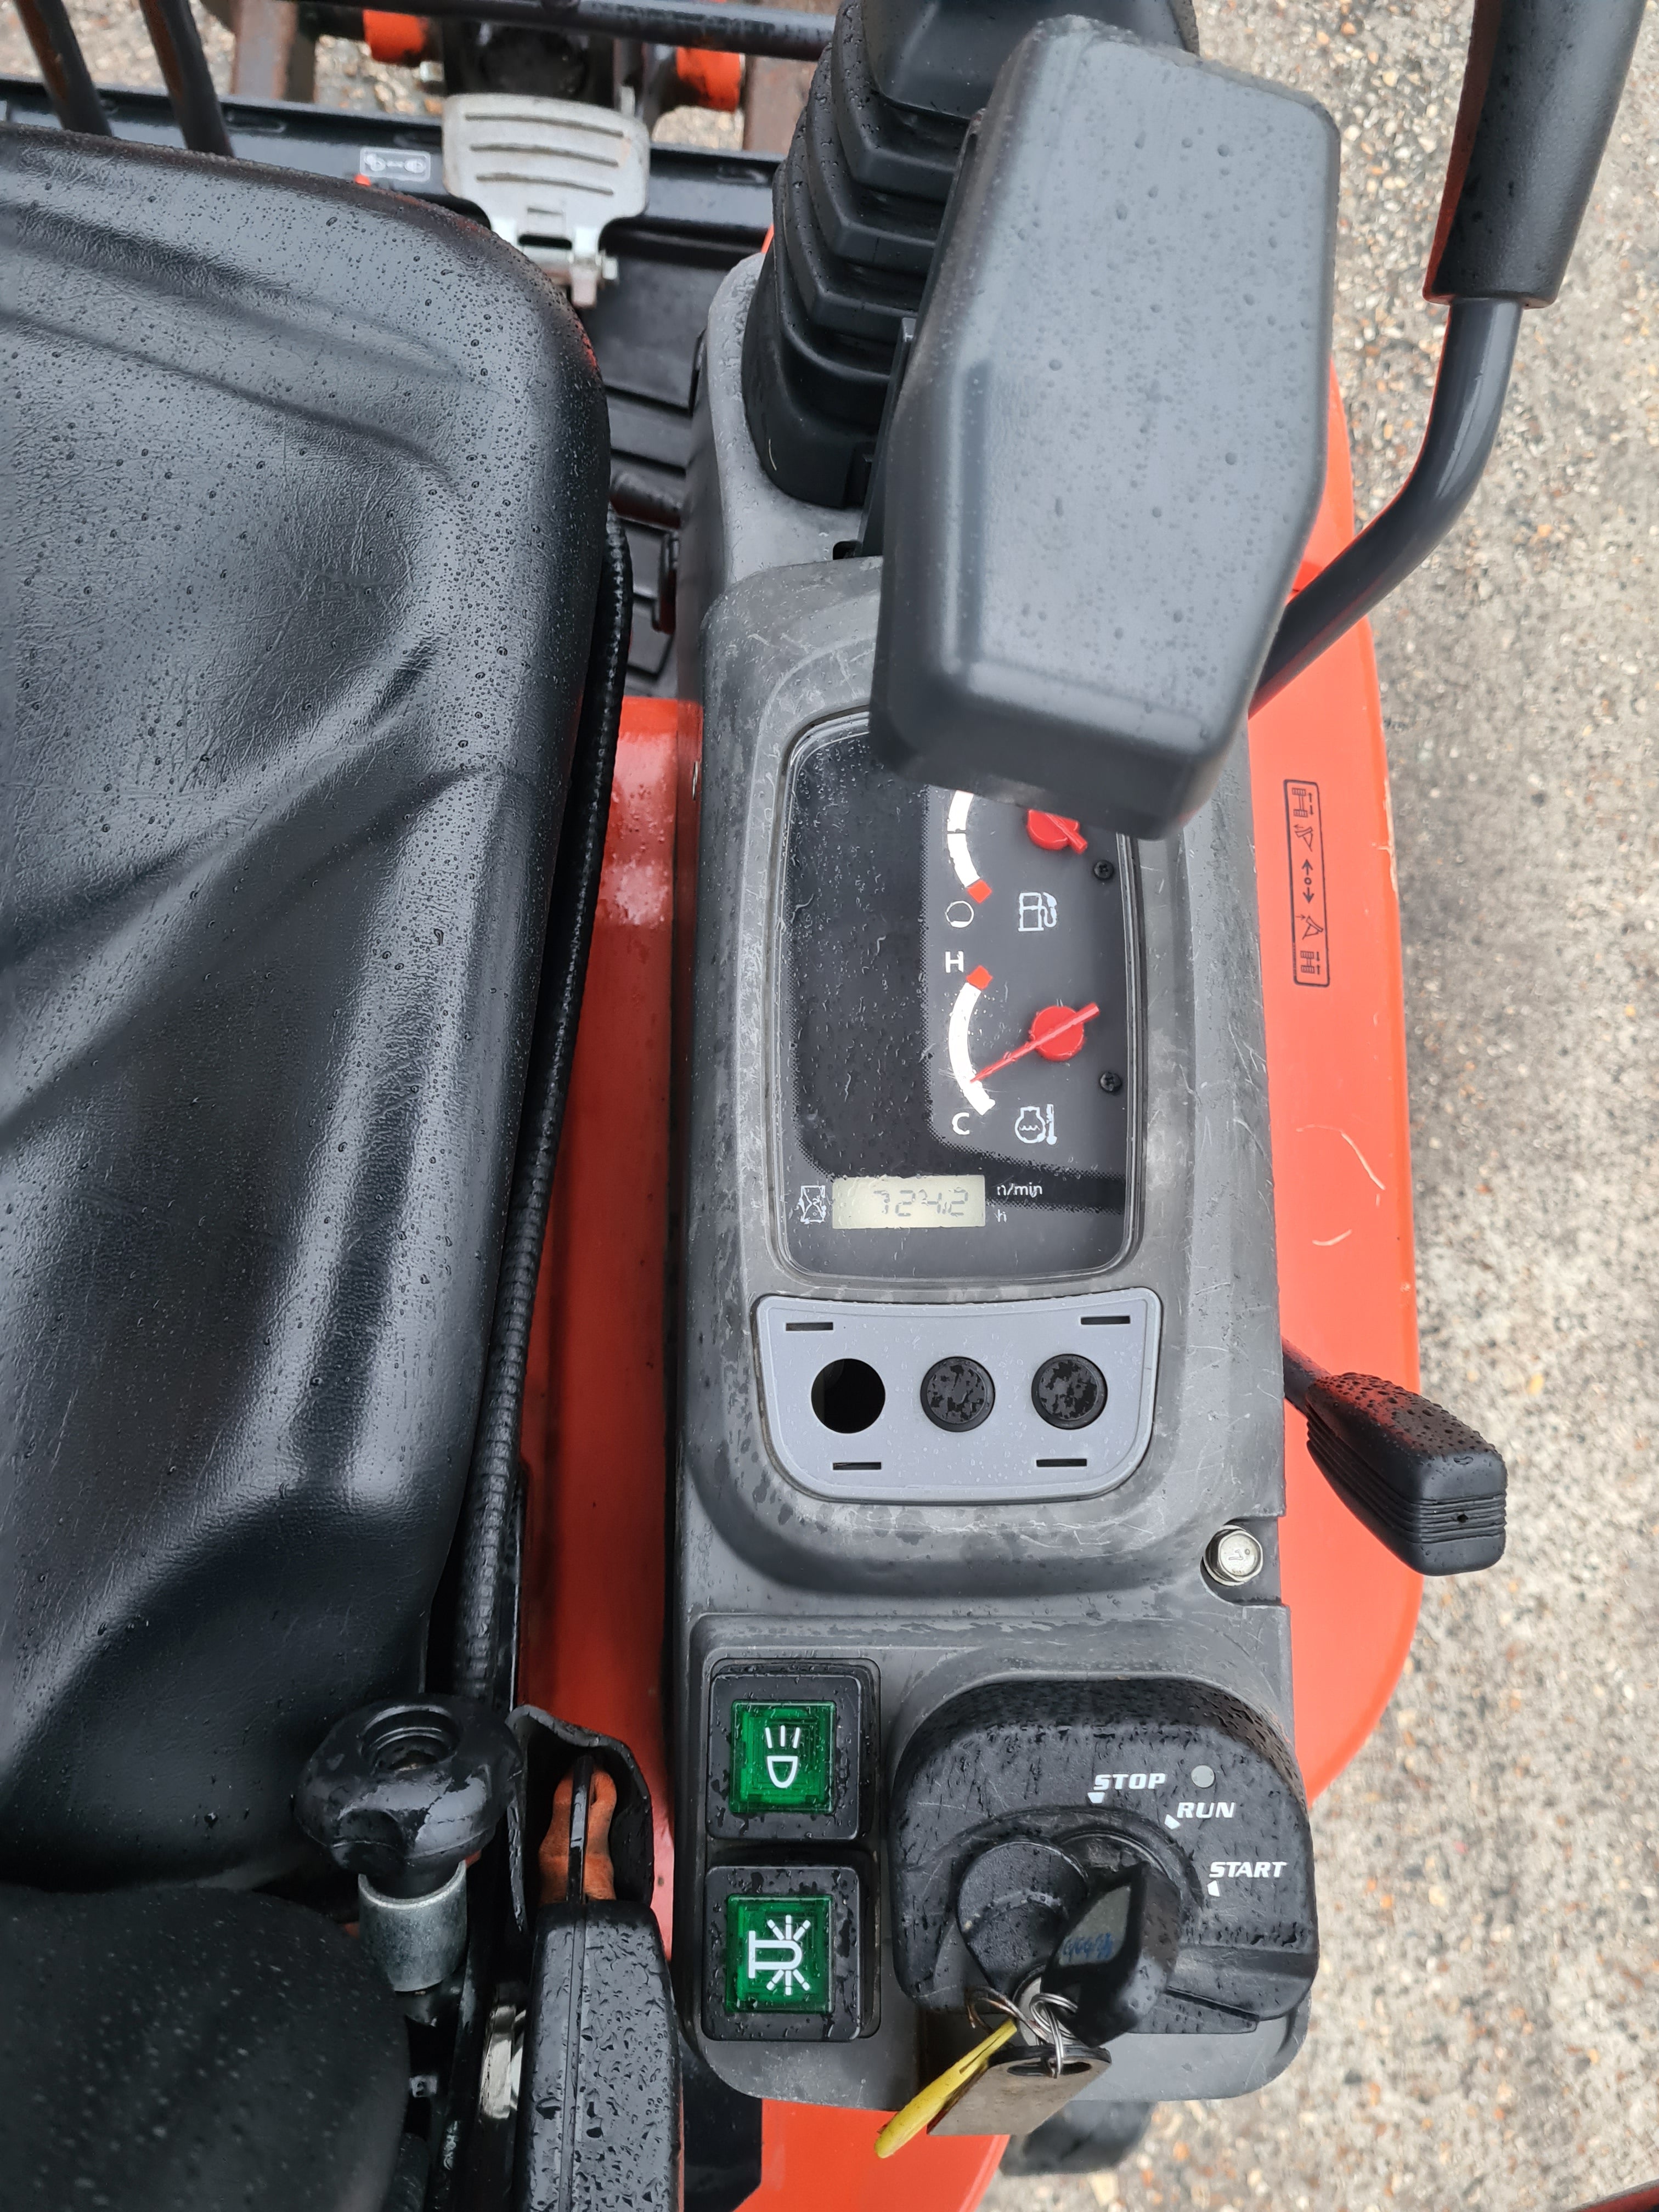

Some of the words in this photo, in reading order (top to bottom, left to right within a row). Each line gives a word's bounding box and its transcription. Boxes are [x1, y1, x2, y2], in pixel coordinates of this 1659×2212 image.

[945, 950, 964, 973] H
[951, 1111, 970, 1135] C
[996, 1182, 1043, 1197] n/min
[1093, 1773, 1166, 1791] STOP
[1176, 1802, 1236, 1819] RUN
[1209, 1861, 1288, 1878] START
